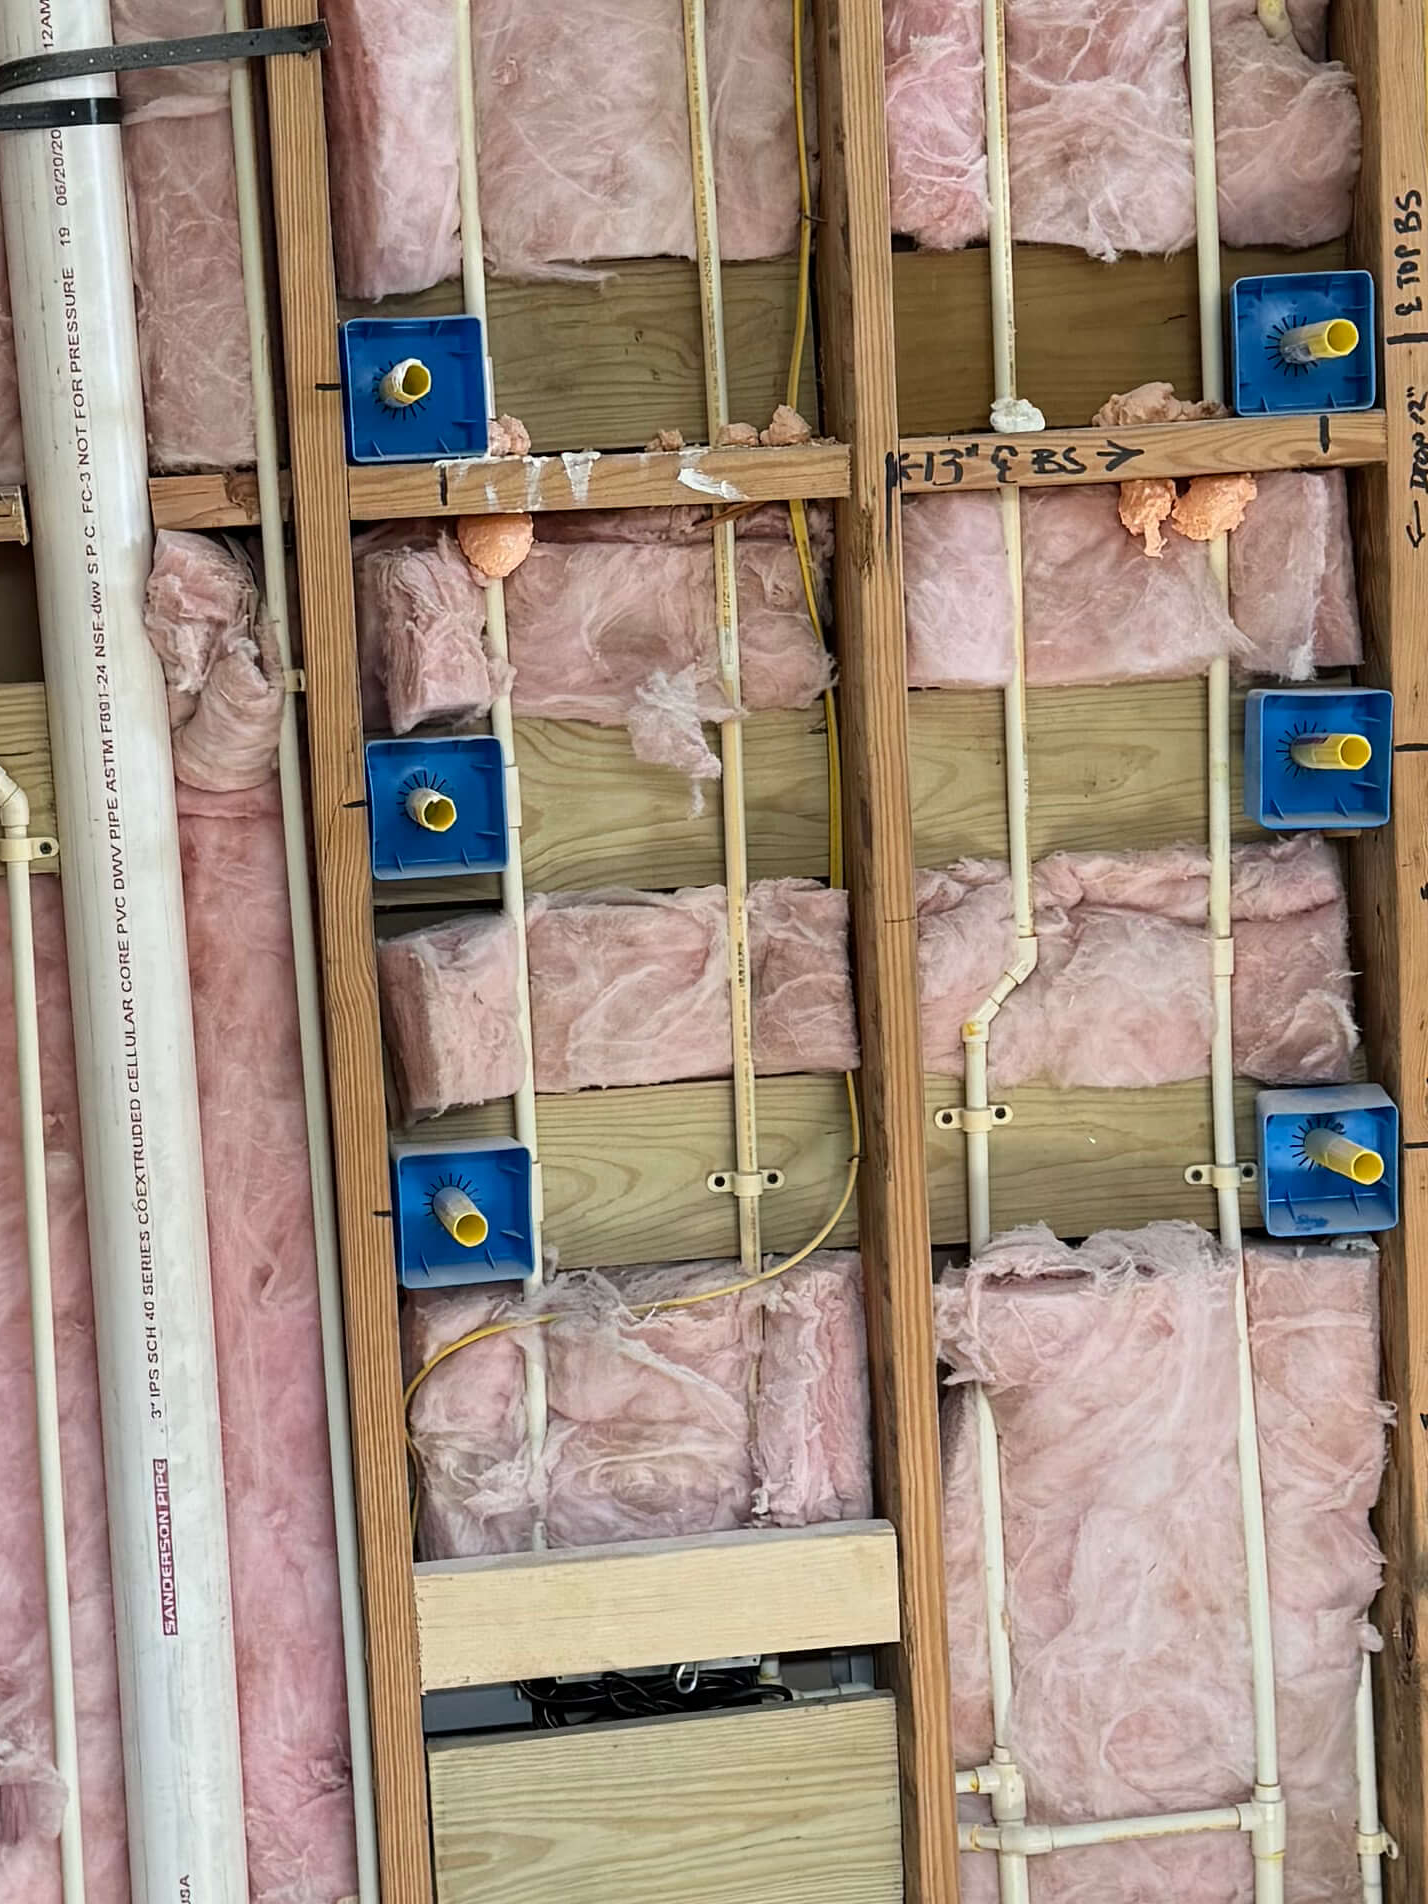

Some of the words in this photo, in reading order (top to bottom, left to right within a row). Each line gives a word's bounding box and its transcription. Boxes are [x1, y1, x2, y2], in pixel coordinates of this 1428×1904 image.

[1393, 189, 1422, 234] BS
[58, 226, 72, 246] 19
[1394, 244, 1420, 290] TOP
[60, 267, 82, 373] PRESSURE
[69, 378, 86, 419] FOR
[74, 426, 90, 466] NOT
[1030, 446, 1088, 475] BS
[79, 471, 95, 513] FC-3
[101, 739, 118, 792] ASTM
[105, 797, 122, 839] PIPE
[109, 845, 125, 890] DWV
[113, 896, 129, 934] PVC
[117, 940, 133, 993] CORE
[120, 998, 140, 1093] CELLULAR
[129, 1098, 150, 1225] COEXTRUDED
[137, 1230, 155, 1296] SERIES
[142, 1301, 156, 1321] 40
[144, 1326, 159, 1364] SCH
[146, 1368, 161, 1398] IPS
[153, 1459, 169, 1506] PIPE
[156, 1510, 178, 1636] SANDERSON
